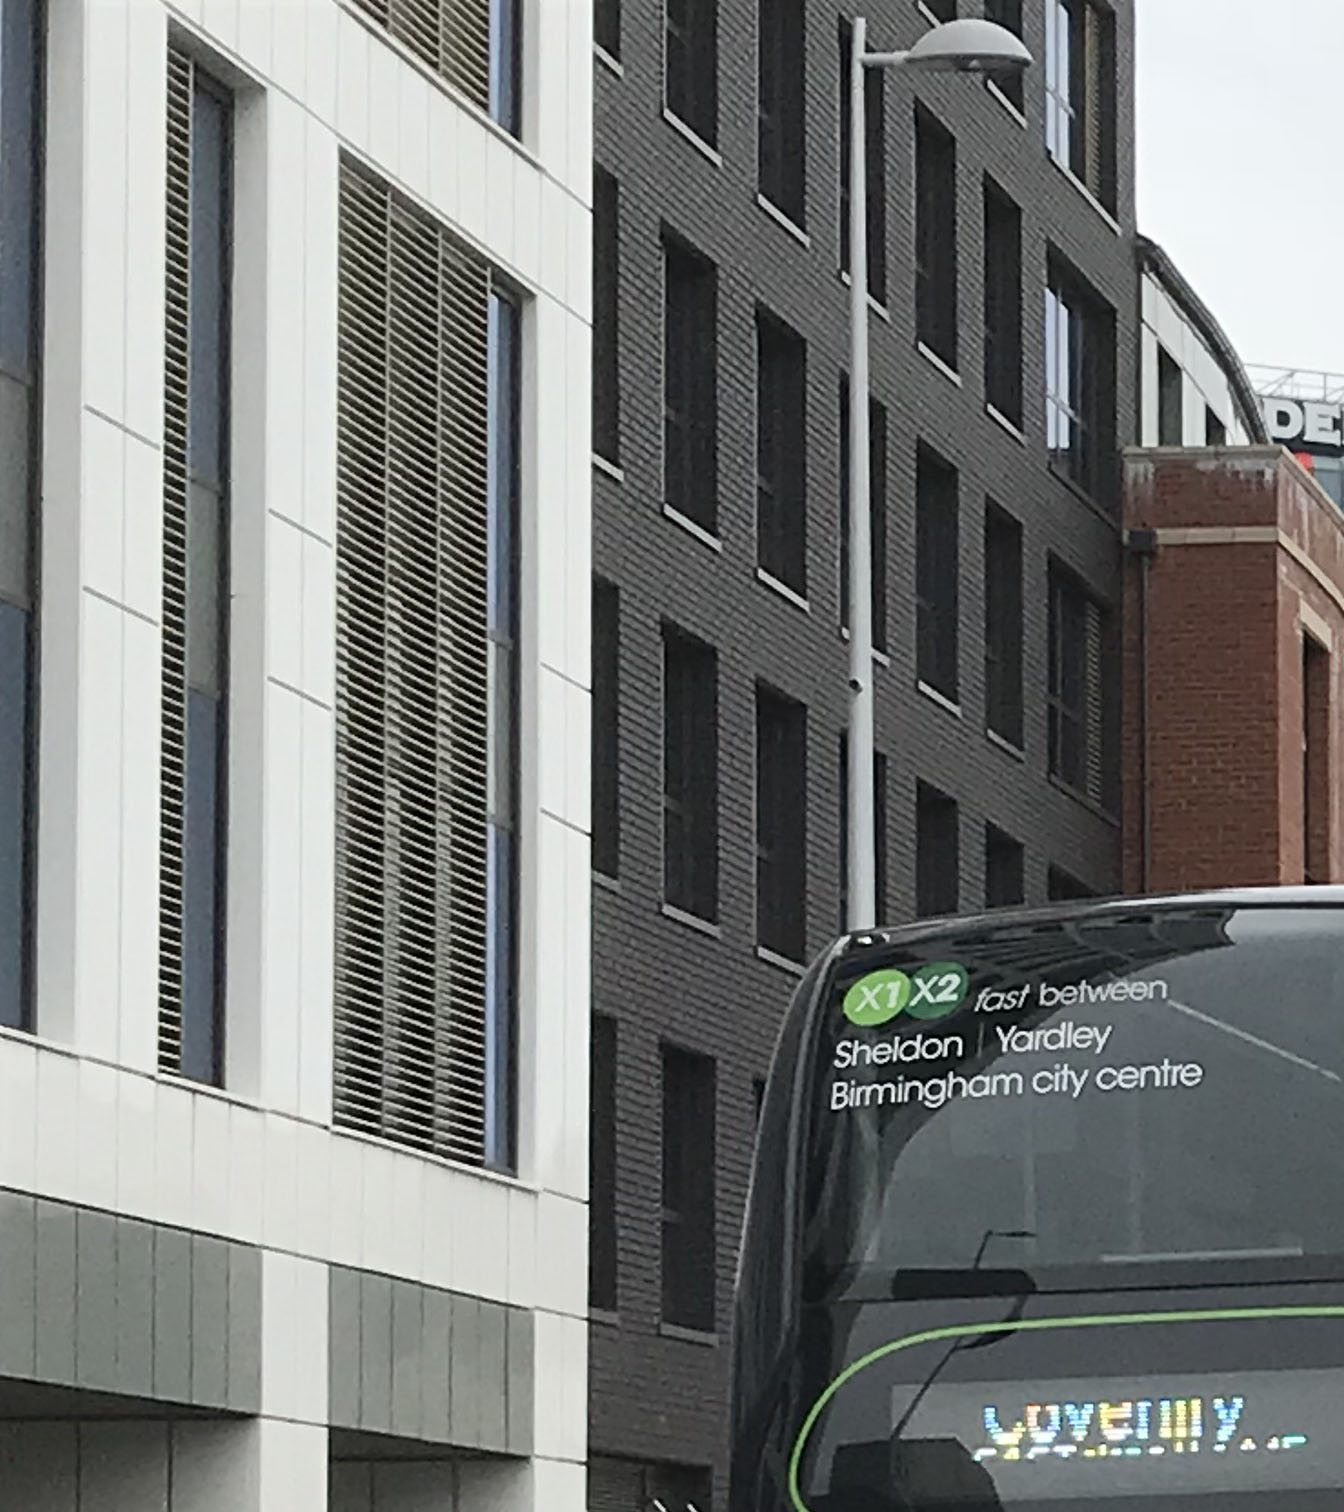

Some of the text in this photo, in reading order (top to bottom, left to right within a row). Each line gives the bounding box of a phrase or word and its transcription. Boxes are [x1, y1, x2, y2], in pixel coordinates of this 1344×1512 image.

[855, 974, 1167, 1013] X1 X2 fast between
[833, 1022, 1112, 1068] Sheldon Yardley
[831, 1058, 1204, 1111] Birmingham city centre
